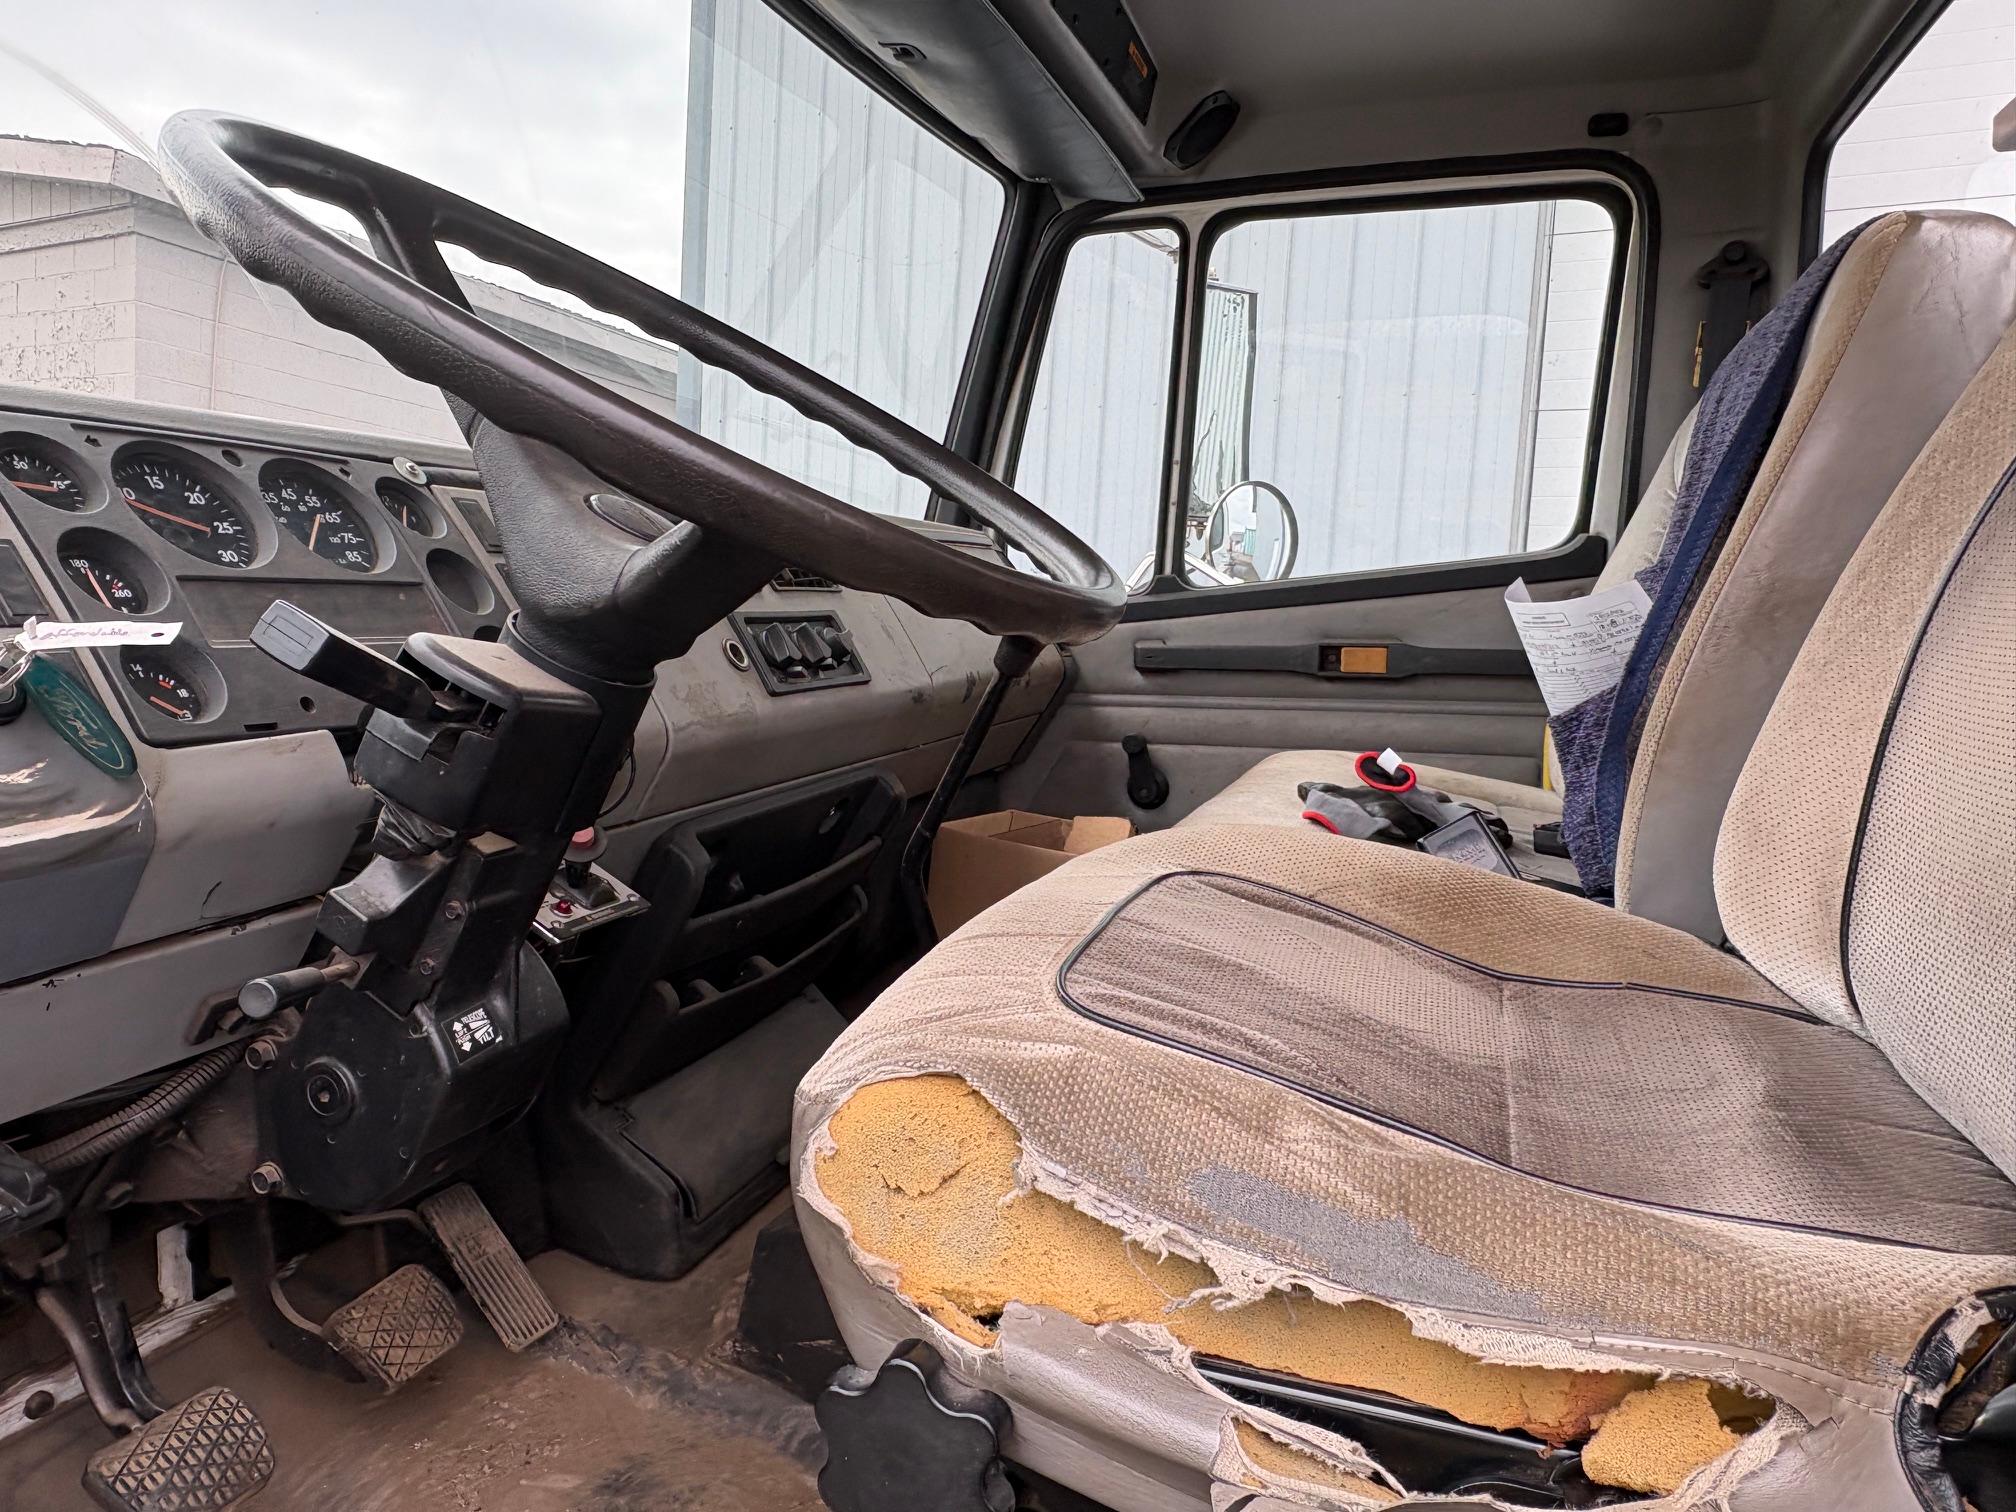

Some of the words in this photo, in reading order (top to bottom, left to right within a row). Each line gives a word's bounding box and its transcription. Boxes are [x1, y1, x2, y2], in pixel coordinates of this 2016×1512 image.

[13, 460, 28, 470] 50
[50, 480, 66, 490] 75
[144, 475, 164, 490] 15
[184, 492, 205, 505] 20
[261, 491, 279, 504] 35
[281, 488, 297, 500] 45
[304, 495, 321, 507] 55
[325, 512, 340, 523] 65
[213, 521, 234, 534] 25
[340, 532, 357, 544] 75
[217, 549, 239, 562] 30
[345, 551, 362, 562] 85
[69, 559, 89, 568] 180
[111, 589, 133, 598] 260
[130, 663, 143, 671] 14
[176, 688, 190, 698] 18
[477, 1026, 495, 1044] TILT
